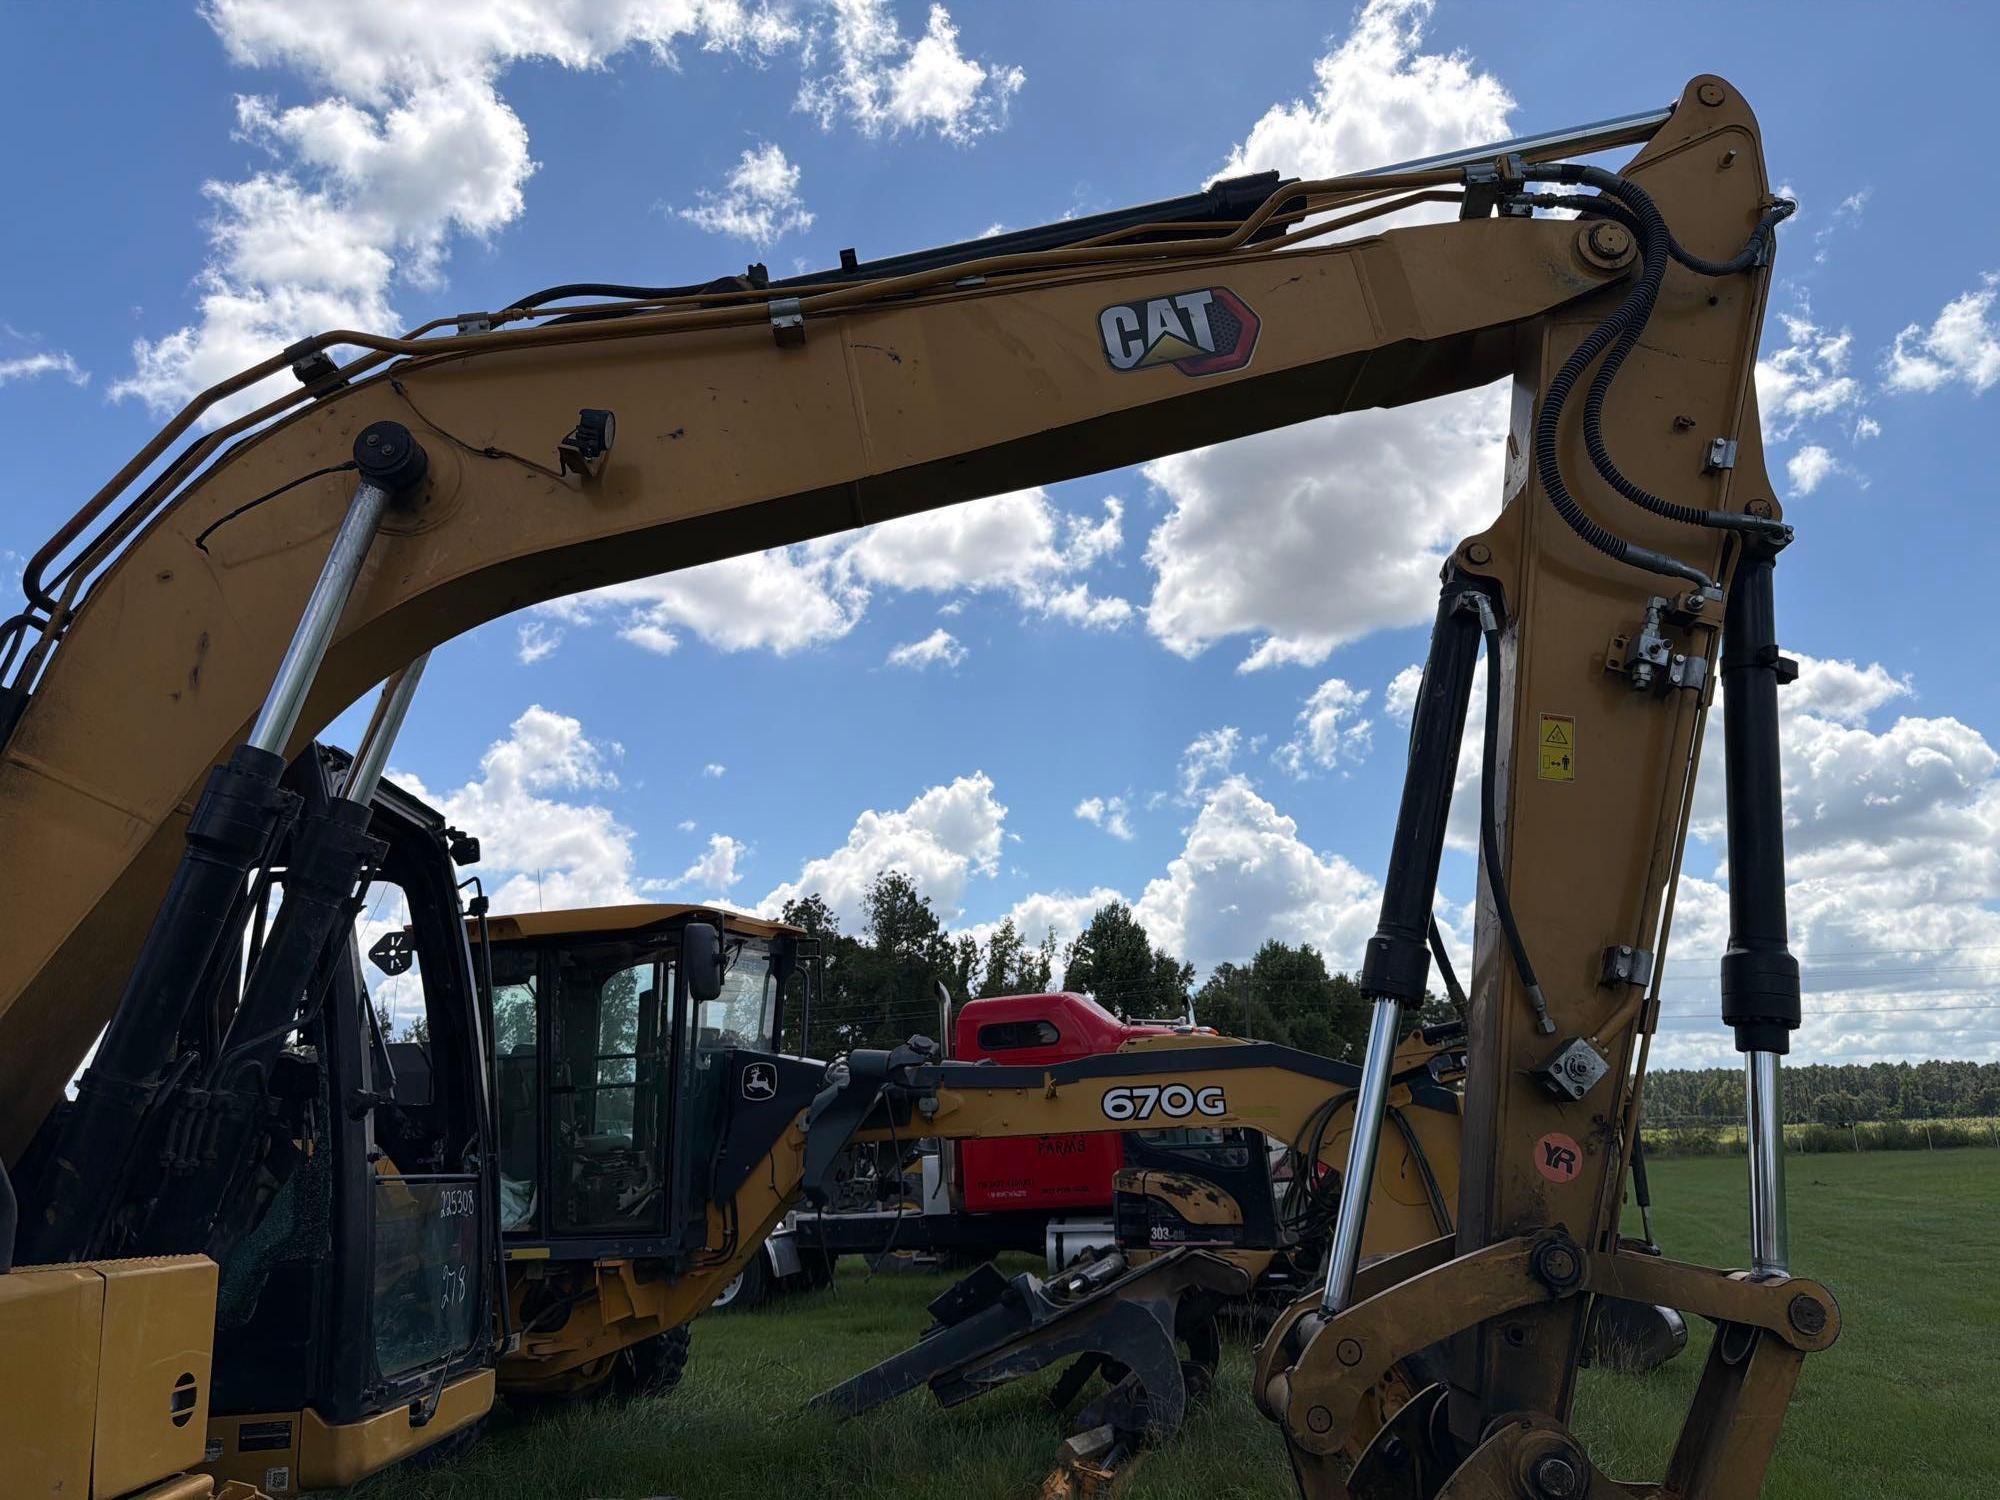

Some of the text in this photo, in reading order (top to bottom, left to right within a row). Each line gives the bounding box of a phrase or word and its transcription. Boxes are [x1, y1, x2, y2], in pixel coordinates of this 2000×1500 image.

[1100, 290, 1216, 369] CAT
[1101, 1083, 1226, 1120] 670G
[1038, 1139, 1086, 1154] FARMS
[1544, 1141, 1576, 1174] YR
[440, 1189, 475, 1218] 225308
[440, 1264, 466, 1310] 278
